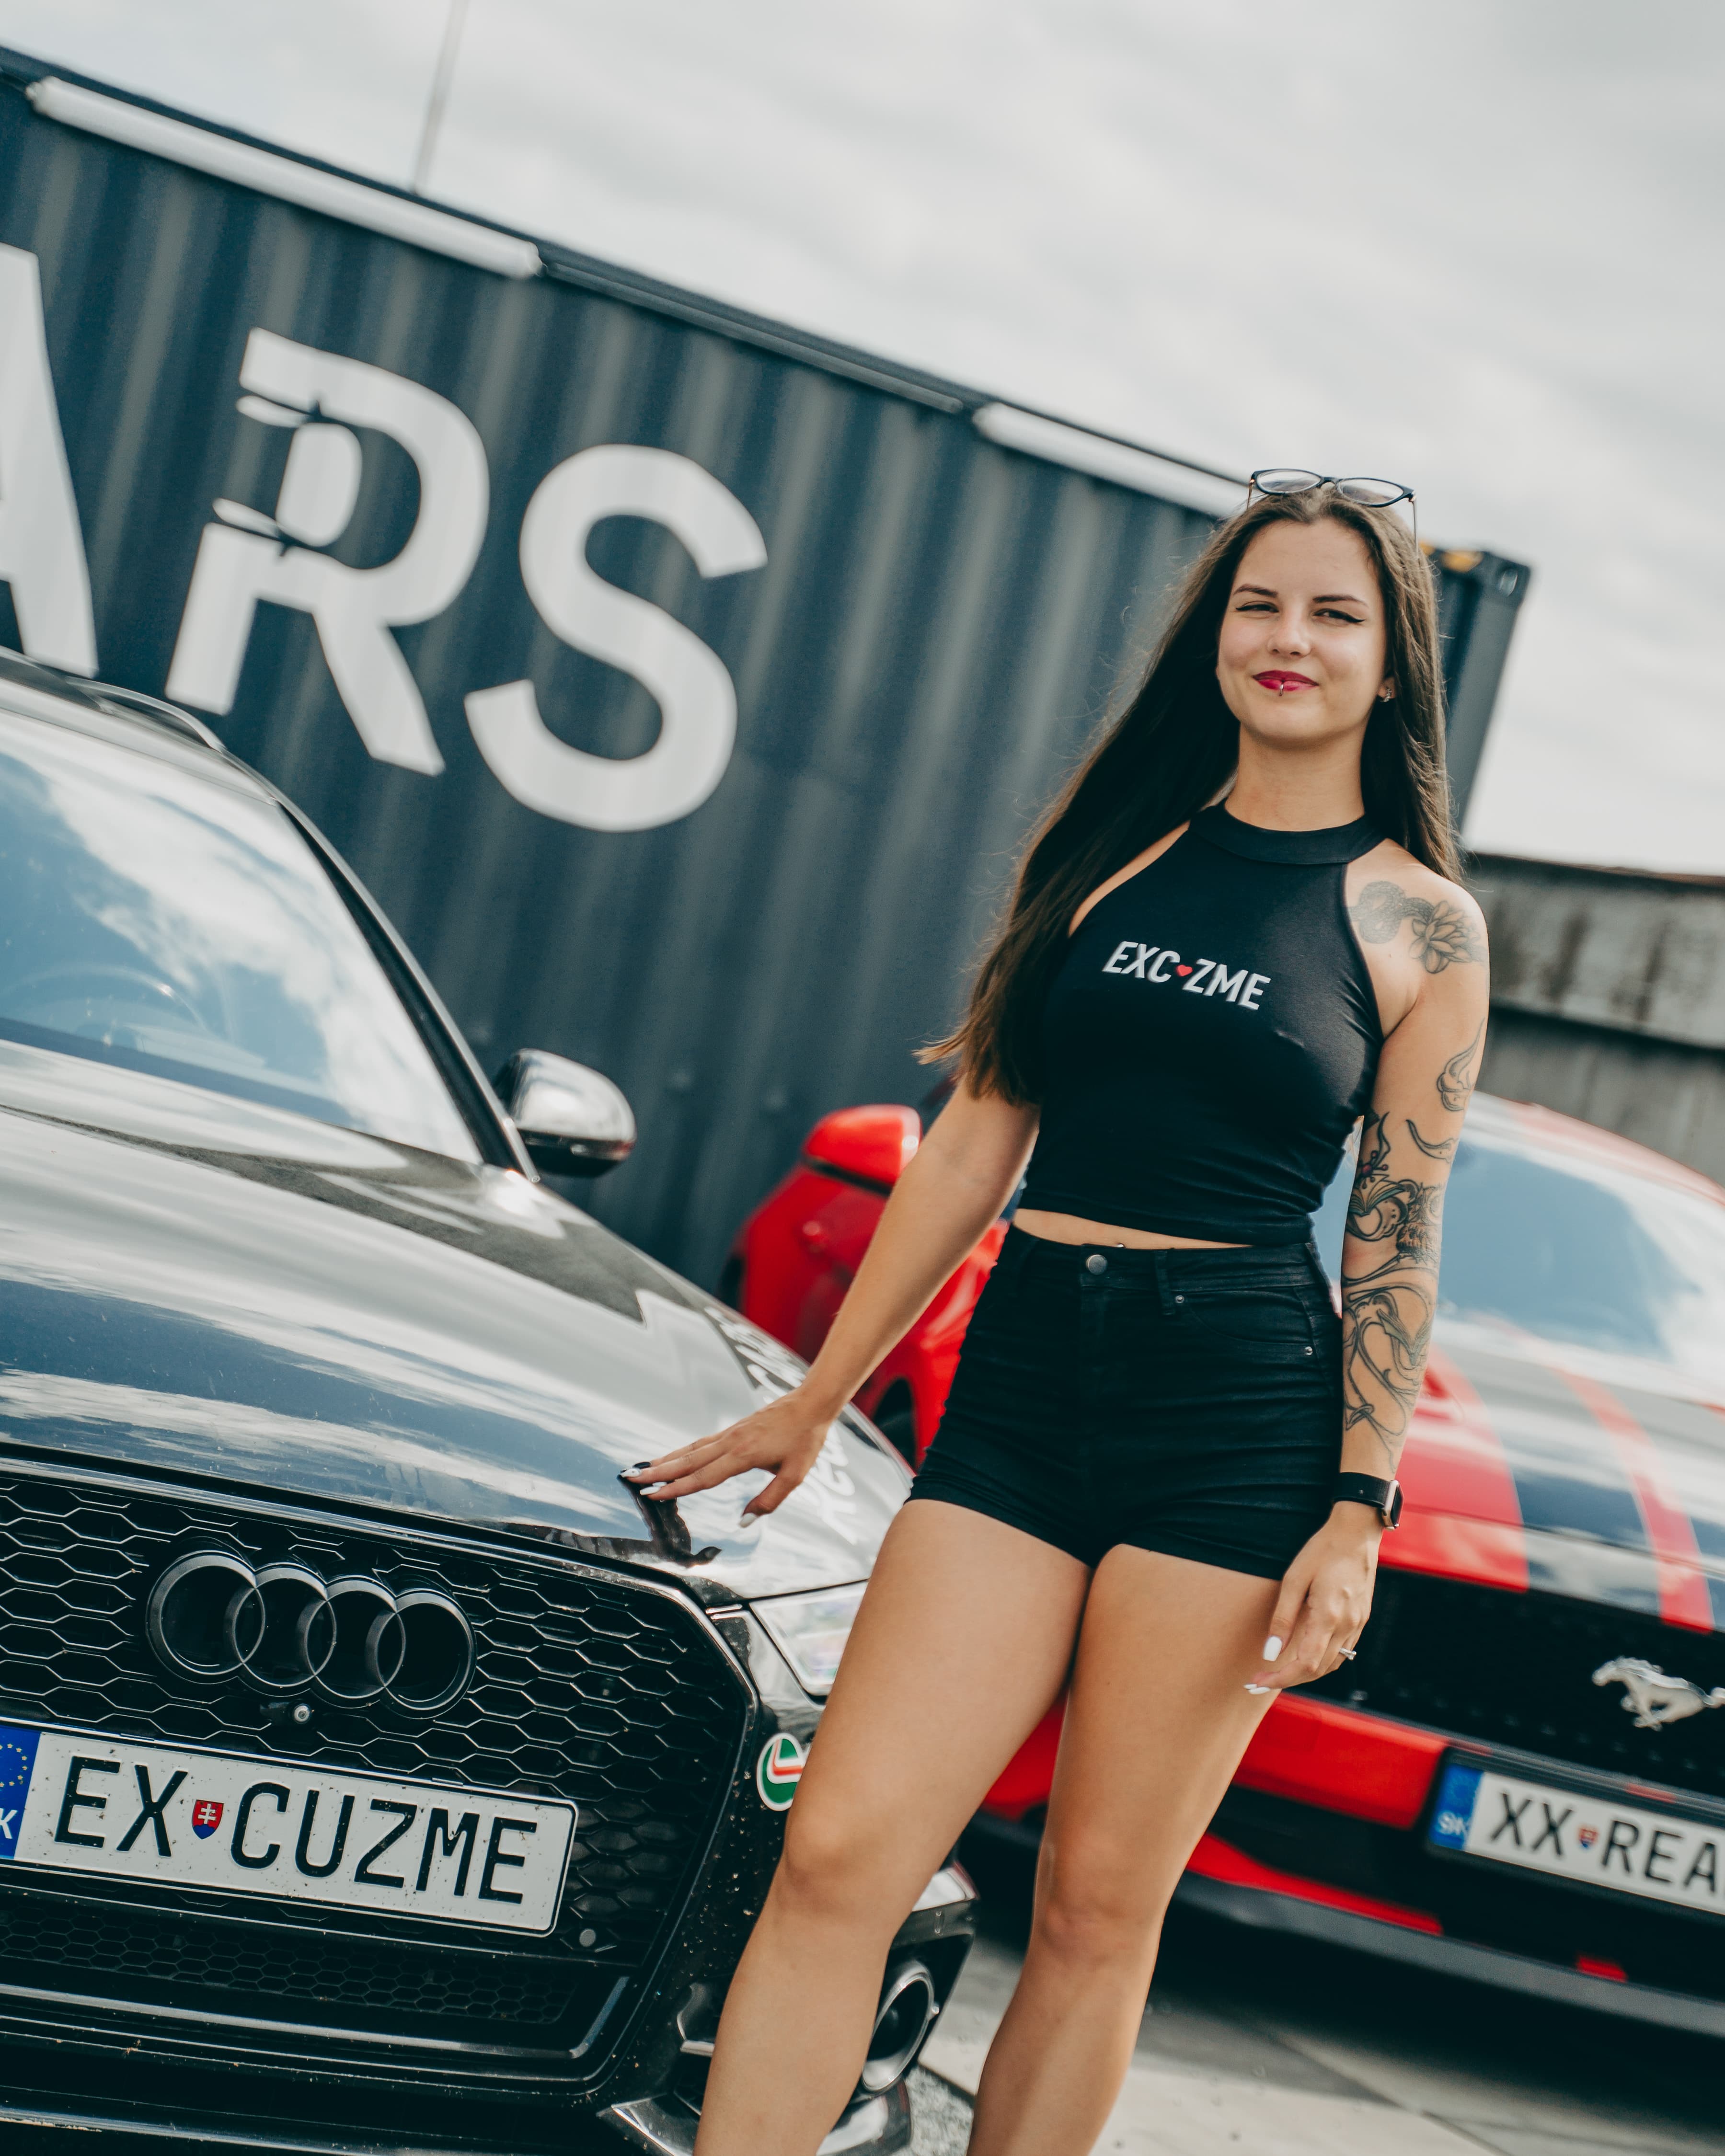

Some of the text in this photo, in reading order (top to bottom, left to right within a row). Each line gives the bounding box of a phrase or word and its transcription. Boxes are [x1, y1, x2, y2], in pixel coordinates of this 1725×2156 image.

[54, 1755, 538, 1905] EX CUZME
[1490, 1792, 1574, 1858] XX
